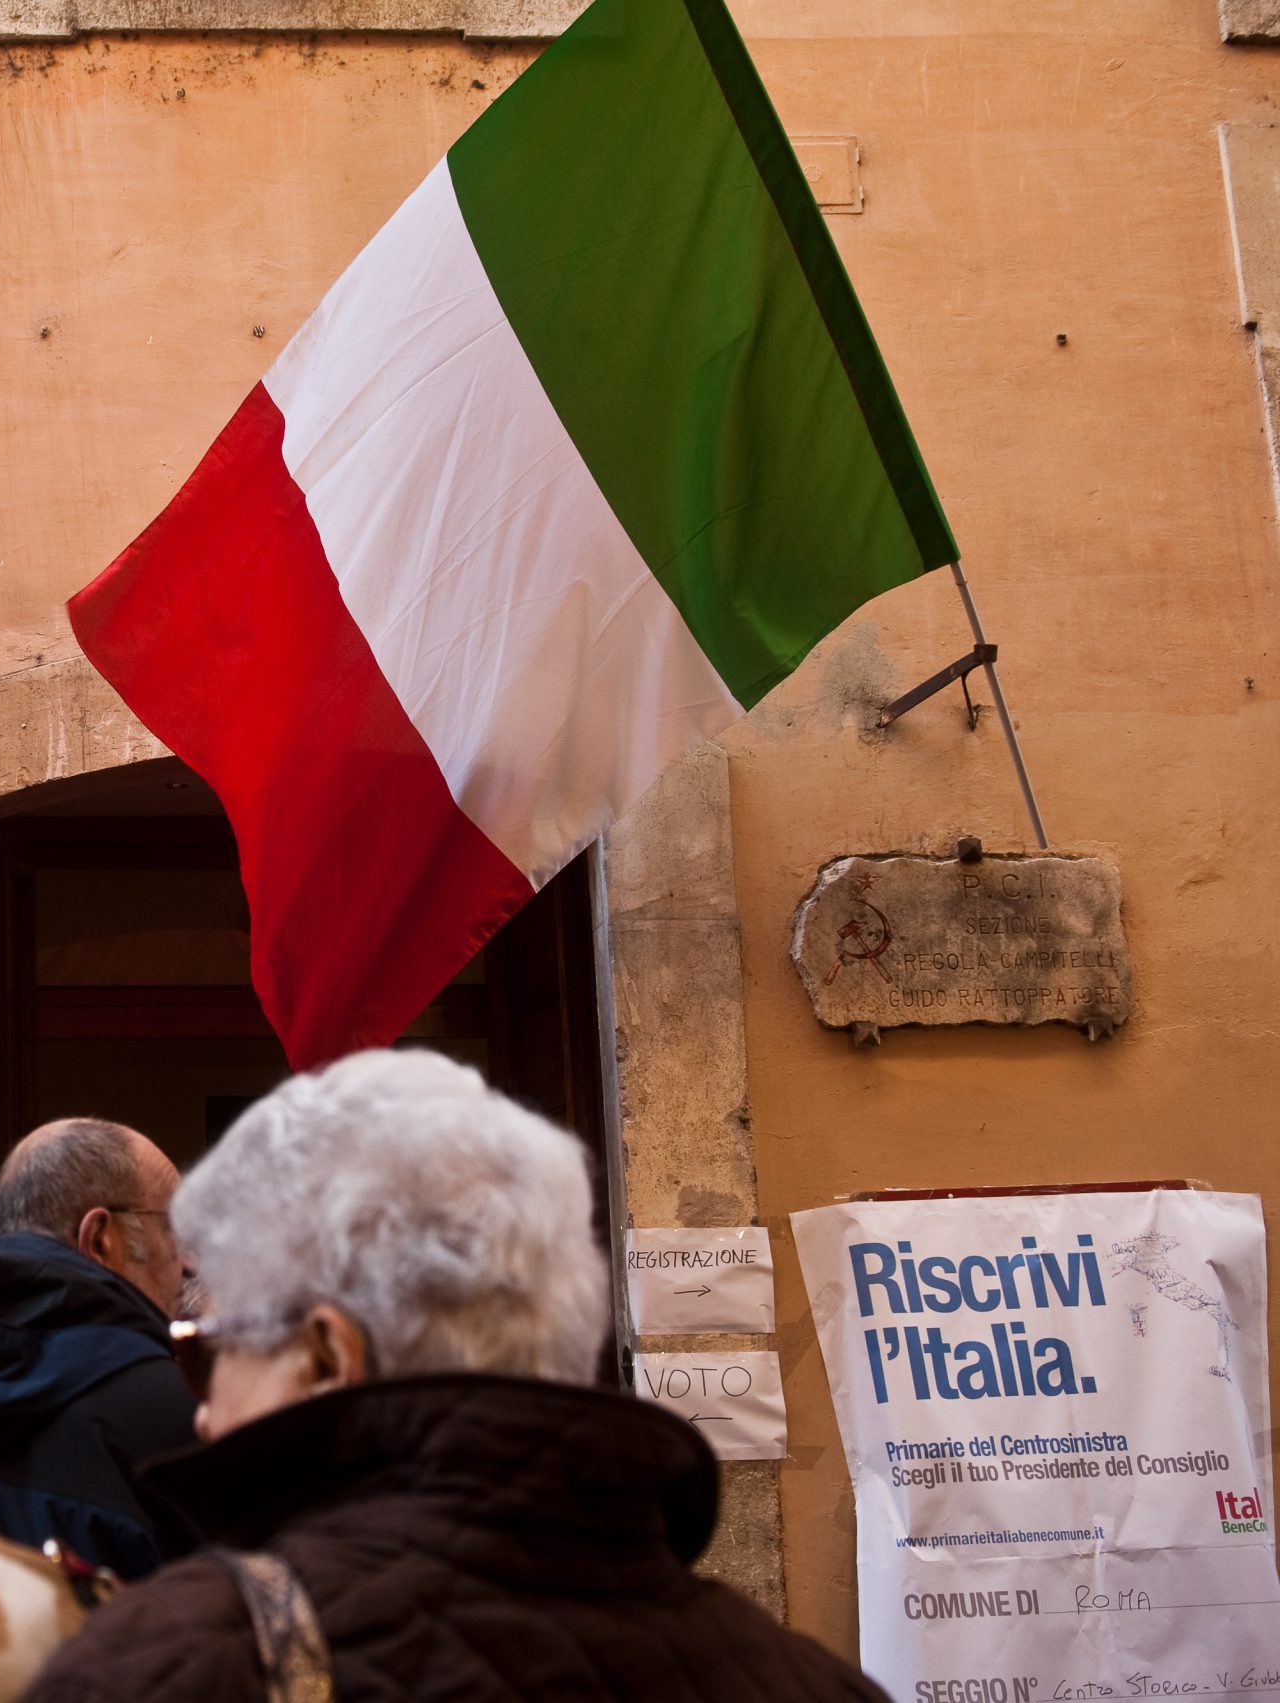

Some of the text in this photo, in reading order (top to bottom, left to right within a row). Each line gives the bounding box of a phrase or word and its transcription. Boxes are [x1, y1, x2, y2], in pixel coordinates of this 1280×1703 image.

[965, 917, 1051, 935] SEZIONE
[888, 986, 1119, 1008] GUIDO RATTOPPATORE
[627, 1249, 758, 1271] REGISTRAZIONE
[848, 1234, 1107, 1317] Riscrivi
[643, 1365, 752, 1400] VOTO
[885, 1431, 1129, 1463] Primarie del Centrosinistra
[891, 1450, 1230, 1490] Scegli il tuo Presidente del Consiglio
[1215, 1486, 1263, 1521] Ital
[896, 1526, 1105, 1550] www.primarieitaliabenecomune.it
[903, 1589, 1040, 1620] COMUNE DI
[1074, 1585, 1152, 1615] ROMA
[915, 1678, 1008, 1703] SEGGIO
